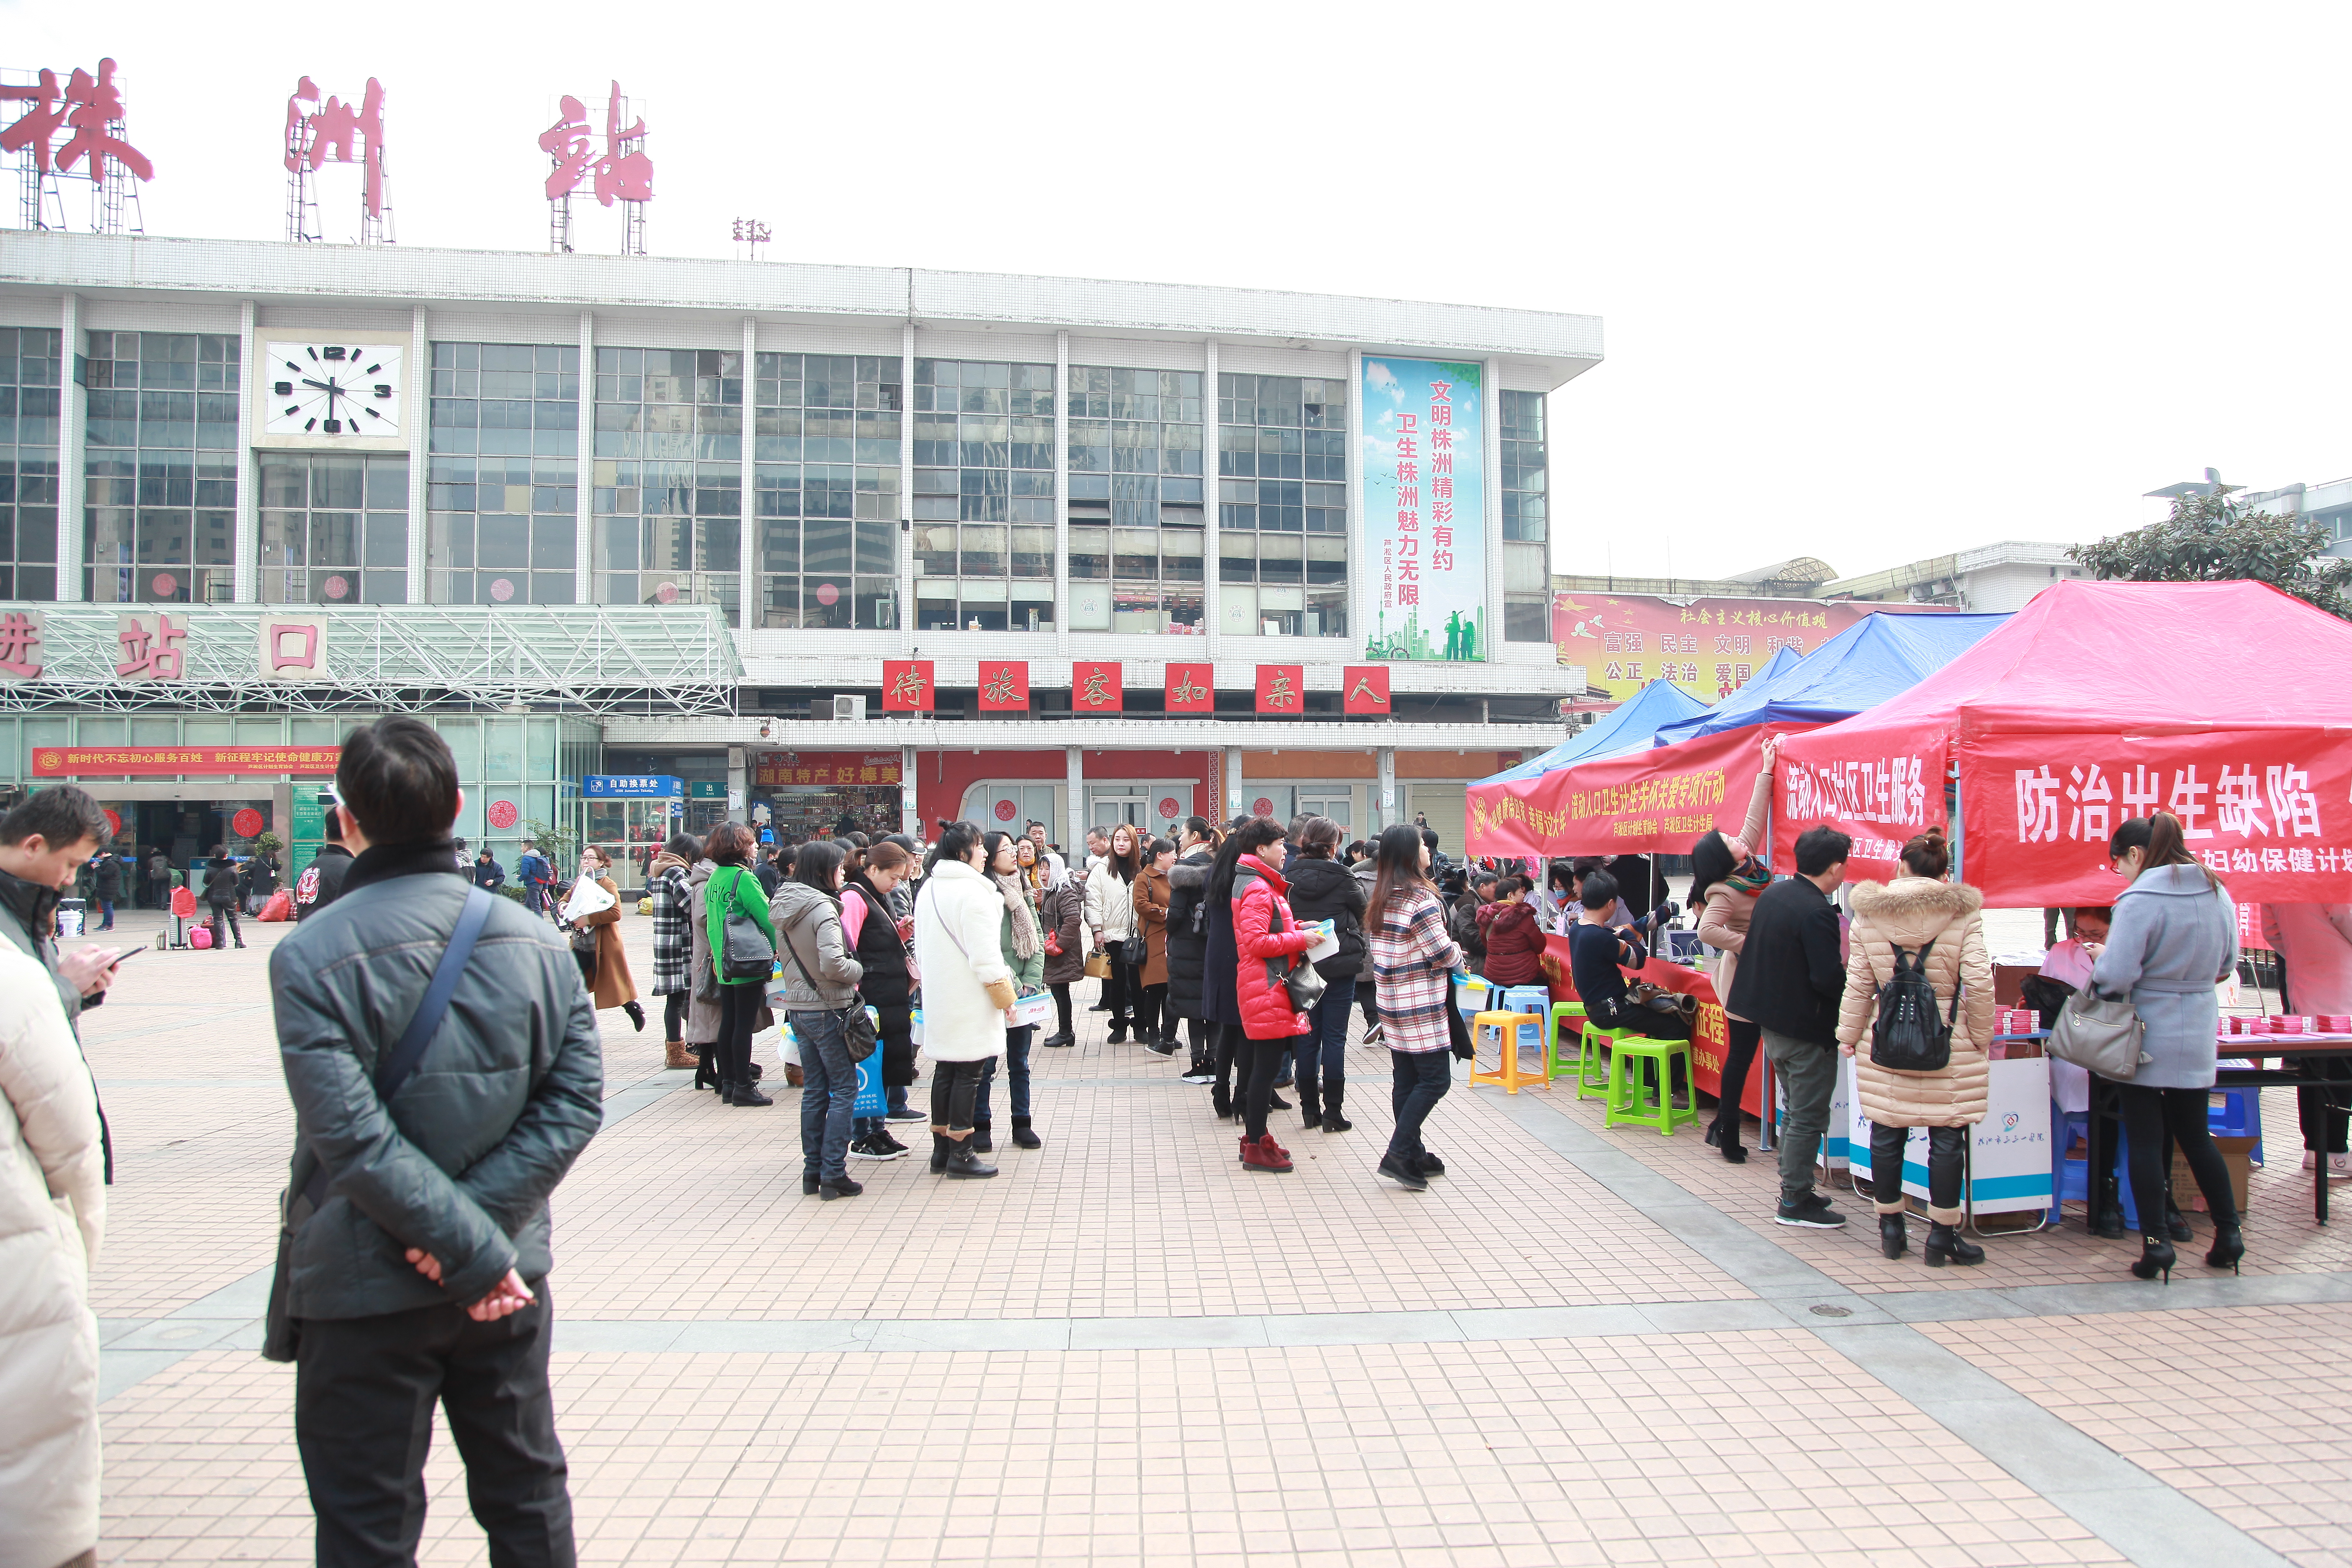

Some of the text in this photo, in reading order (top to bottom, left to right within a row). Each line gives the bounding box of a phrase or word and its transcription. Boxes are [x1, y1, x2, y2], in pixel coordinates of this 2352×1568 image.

[374, 384, 392, 398] 3
[1430, 380, 1453, 572] 文明株洲精彩有约
[1397, 413, 1419, 606] 卫生株洲魅力无限
[1383, 539, 1393, 608] 芦淞区人民政府宣
[1680, 609, 1828, 629] 社会主义核心价值观
[1604, 632, 1804, 657] 富强 民主 文明 和谐
[890, 665, 1386, 708] 待旅客如亲人
[1605, 662, 1751, 683] 公正 法治 爱国
[67, 753, 203, 763] 新时代不忘初心服务百姓
[610, 779, 659, 788] 自助换票处
[759, 766, 899, 783] 湖南特产 好棒美
[1571, 766, 1725, 820] 流动人口卫生计生关怀关爱专项行动
[1786, 754, 1925, 826] 流动人口社区卫生服务
[2015, 763, 2321, 843] 防治出生缺陷
[1613, 814, 1713, 837] 芦淞区计划生育协会 芦淞区卫生计生局
[1695, 998, 1725, 1046] 征程
[1692, 1046, 1720, 1075] 道办事处
